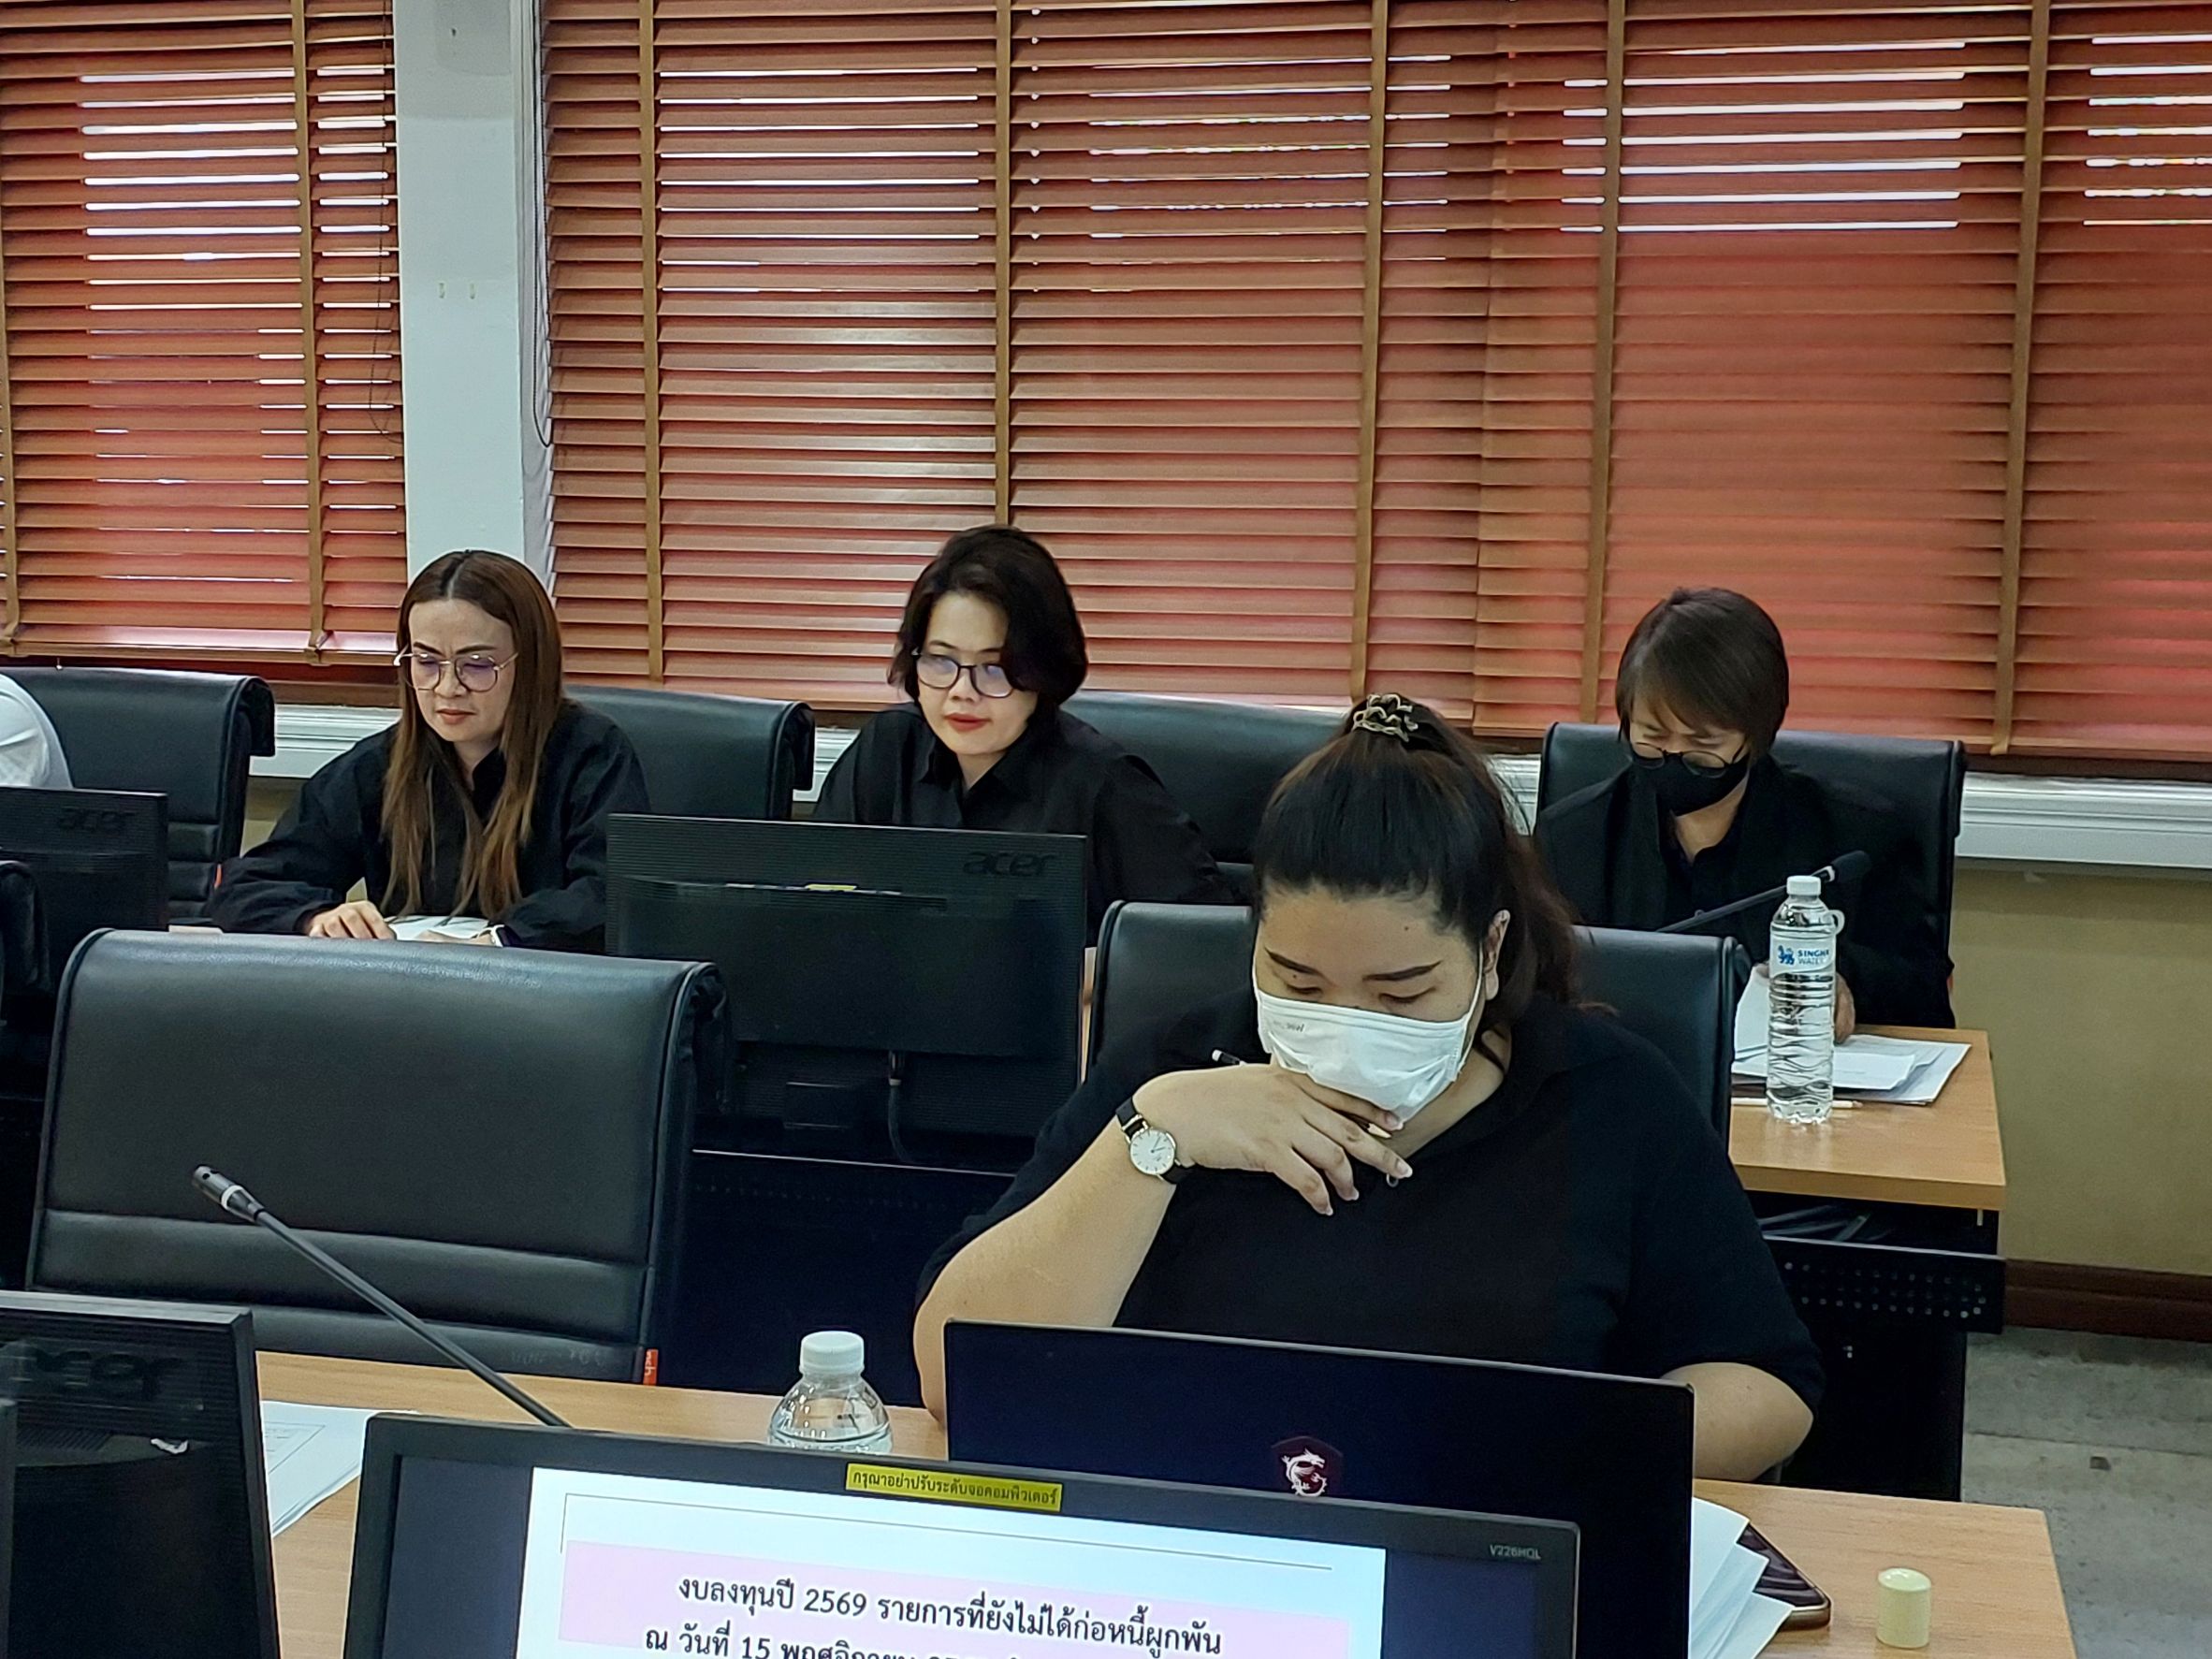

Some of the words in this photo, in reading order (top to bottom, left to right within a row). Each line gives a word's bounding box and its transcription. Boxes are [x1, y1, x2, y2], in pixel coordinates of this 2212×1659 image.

[962, 851, 1058, 878] acer
[678, 1578, 794, 1616] งบลงทุนปี
[803, 1588, 866, 1616] 2569
[877, 1591, 1221, 1658] รายการที่ยังไม่ได้ก่อหนี้ผูกพัน
[646, 1628, 668, 1651] ณ
[678, 1620, 731, 1657] วันที่
[741, 1637, 770, 1659] 15
